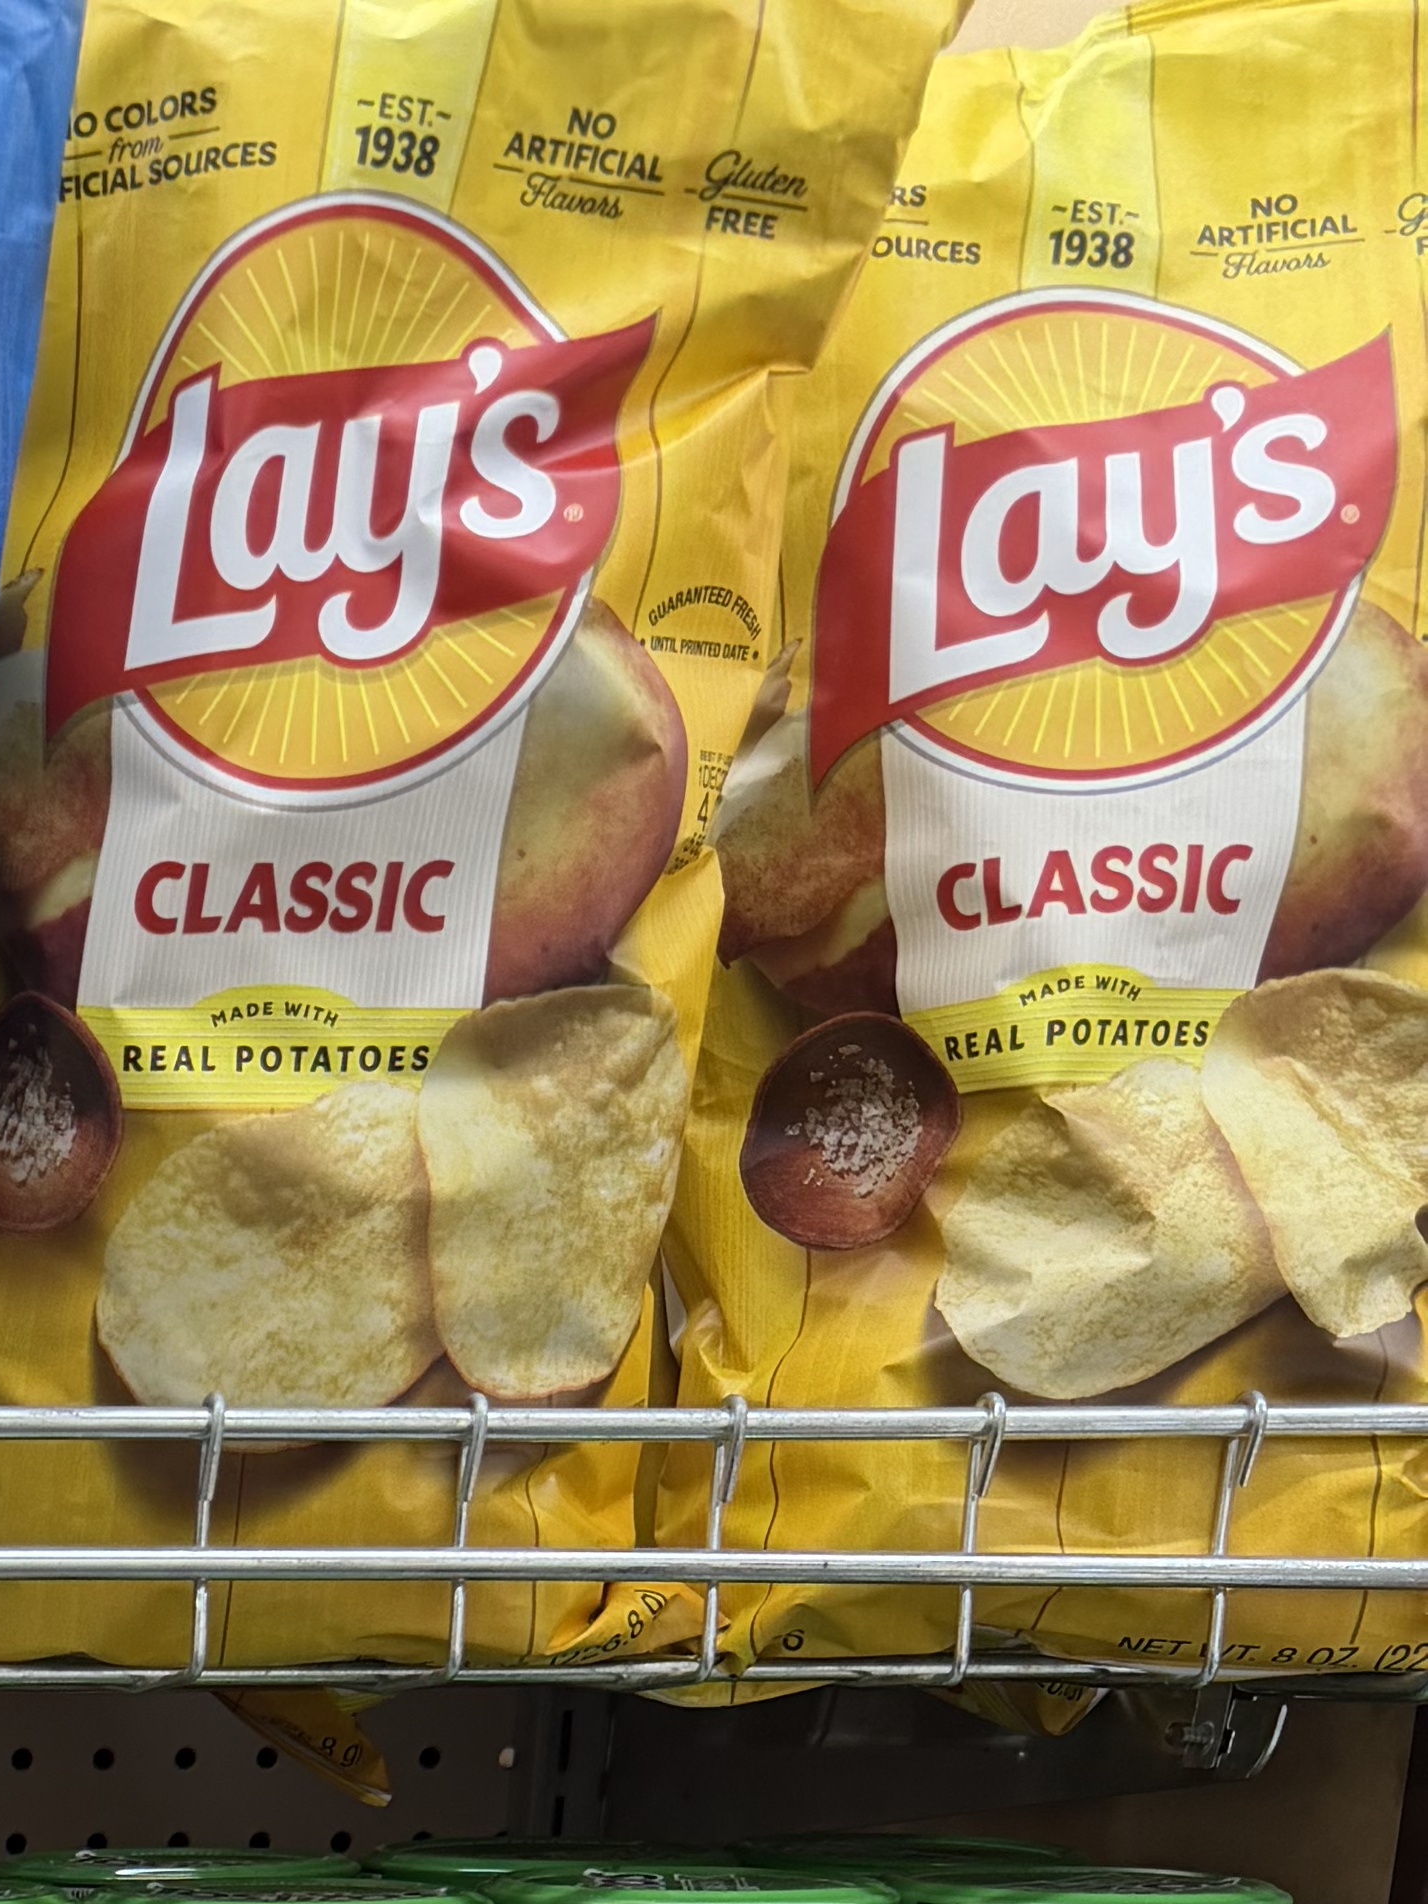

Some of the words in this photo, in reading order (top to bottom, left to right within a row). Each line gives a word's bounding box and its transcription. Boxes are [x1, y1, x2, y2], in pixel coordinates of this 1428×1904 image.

[568, 108, 617, 138] NO
[354, 127, 440, 176] 1938
[503, 131, 663, 182] ARTIFICIAL
[704, 149, 809, 197] Gluten
[520, 174, 623, 220] Flavors
[706, 205, 777, 240] FREE
[1049, 229, 1136, 269] 1938
[125, 345, 559, 671] Lay's
[889, 386, 1336, 705] Lay's
[133, 859, 457, 936] CLASSIC
[936, 843, 1254, 931] CLASSIC
[1118, 1634, 1192, 1660] NET
[1273, 1643, 1297, 1664] 8
[1306, 1644, 1361, 1670] OZ.
